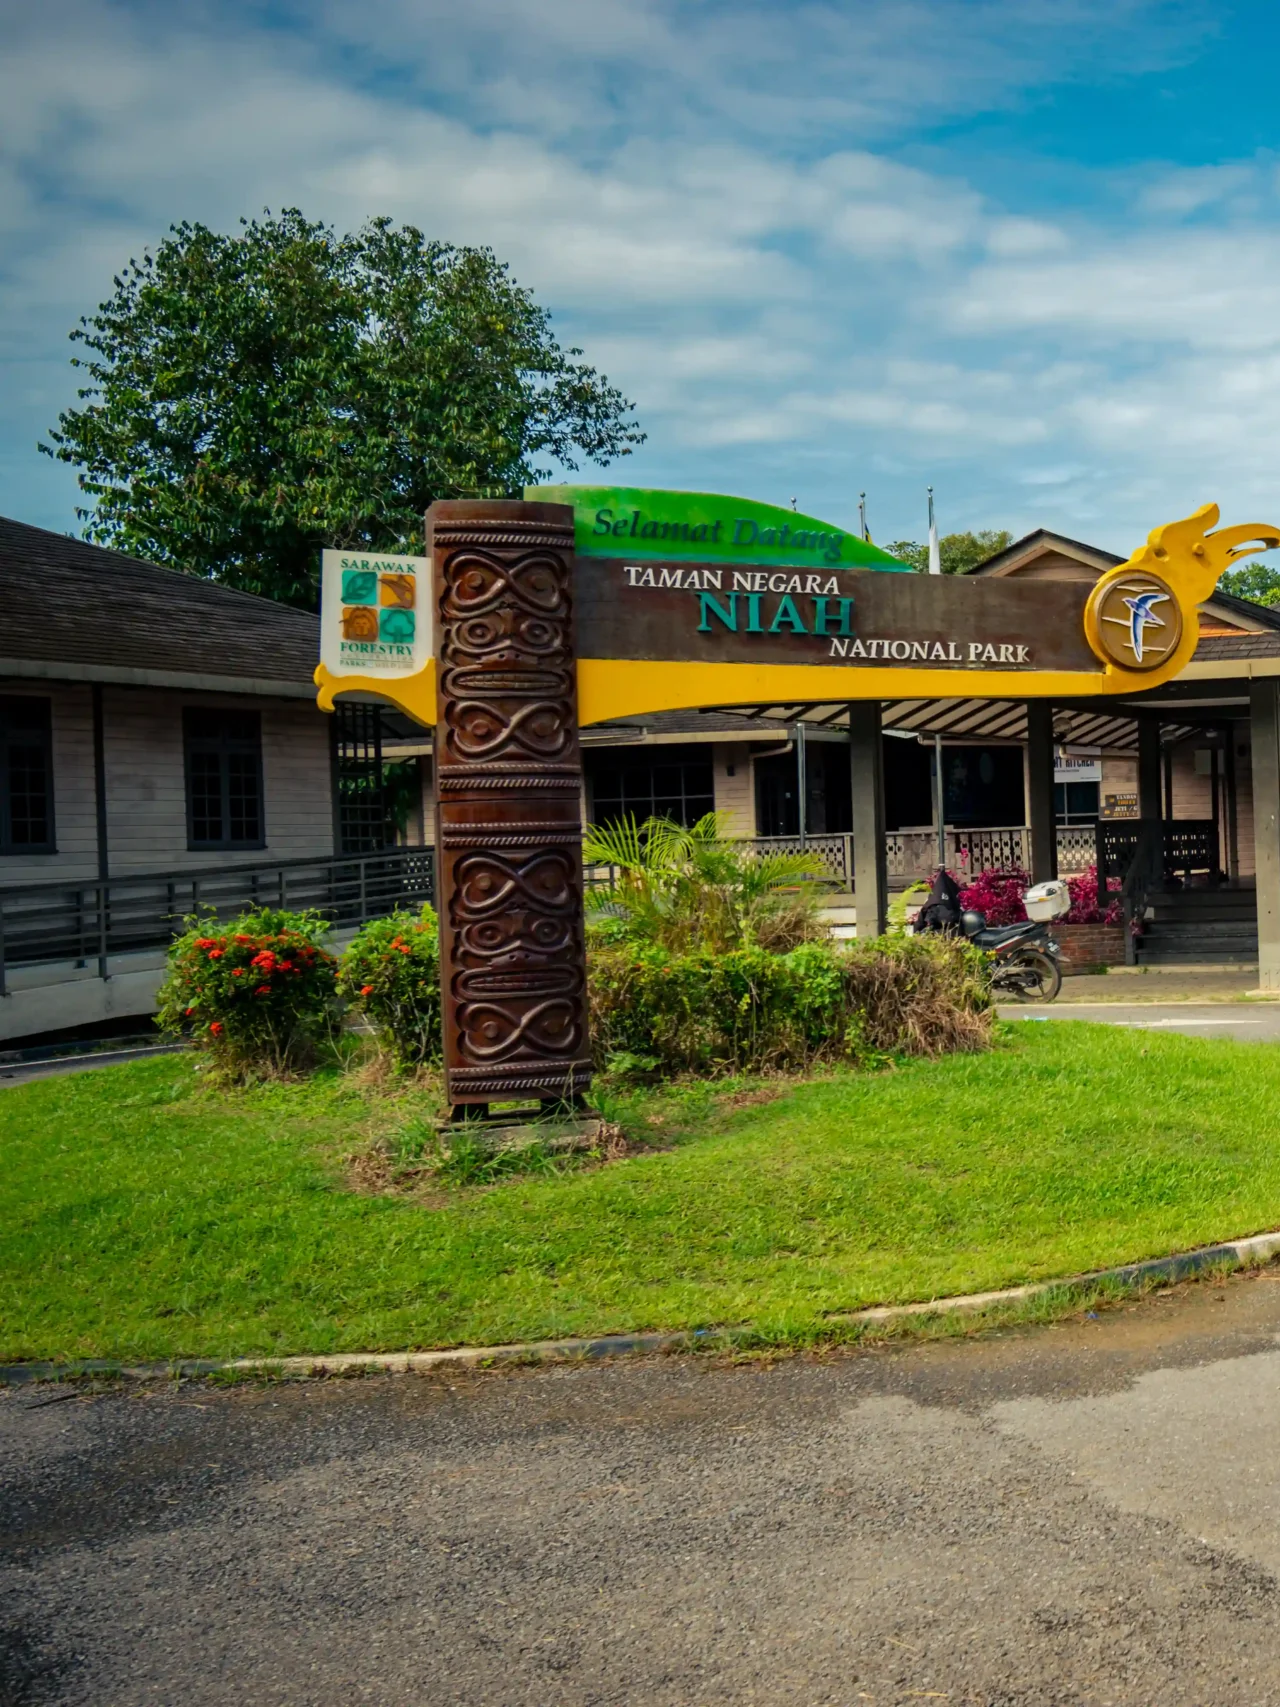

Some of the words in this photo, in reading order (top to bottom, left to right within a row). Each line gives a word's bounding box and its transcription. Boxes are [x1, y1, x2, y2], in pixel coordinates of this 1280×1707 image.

[592, 508, 724, 543] Selamat
[730, 517, 844, 561] Datang
[340, 558, 416, 573] SARAWAK
[623, 566, 723, 590] TAMAN
[731, 571, 841, 595] NEGARA
[695, 591, 855, 636] NIAH
[340, 642, 414, 656] FORESTRY
[828, 637, 963, 661] NATIONAL
[967, 642, 1031, 663] PARK
